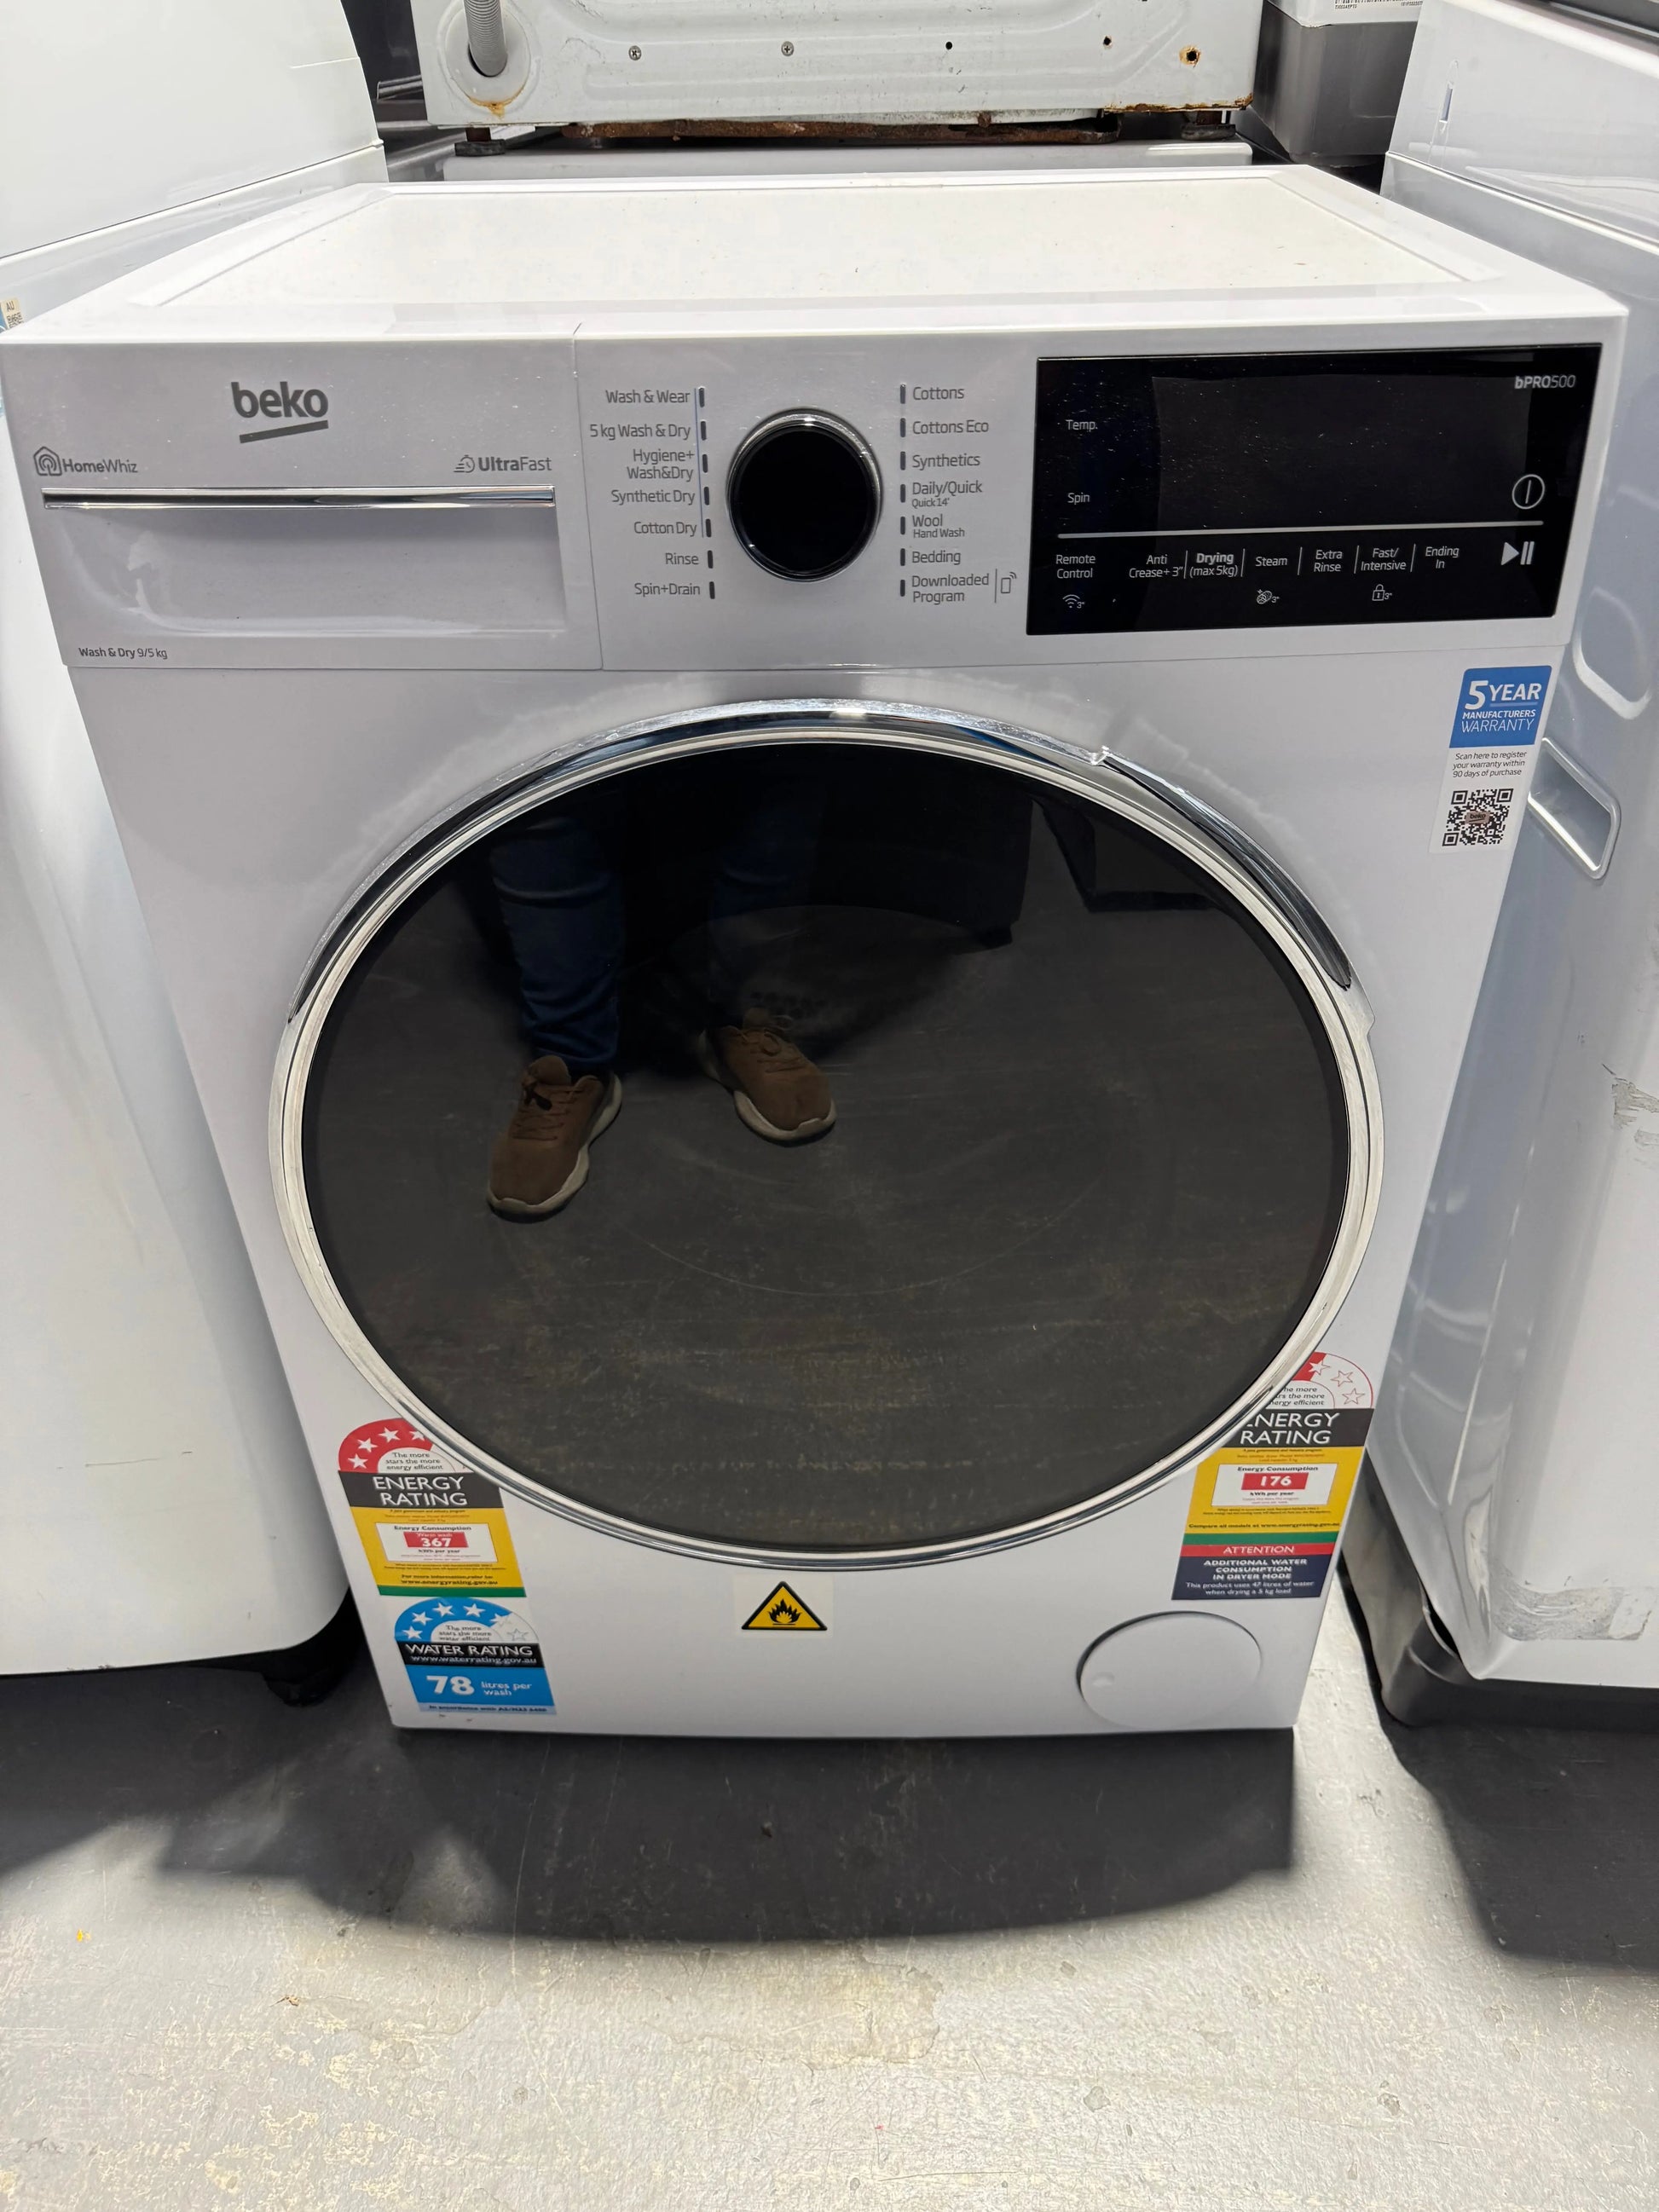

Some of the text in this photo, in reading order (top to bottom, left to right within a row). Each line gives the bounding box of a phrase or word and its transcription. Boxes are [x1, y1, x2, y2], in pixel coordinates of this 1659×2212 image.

[1515, 375, 1576, 389] bPRO500
[231, 381, 329, 419] beko
[605, 390, 691, 404] Wash & Wear
[911, 387, 965, 400] Cottons
[590, 424, 691, 440] 5 kg Wash & Dry
[911, 420, 990, 434] Cottons Eco
[1066, 419, 1098, 432] Temp.
[477, 455, 552, 472] UltraFast
[633, 448, 695, 465] Hygiene+
[911, 453, 980, 470] Synthetics
[63, 459, 138, 474] HomeWhiz
[627, 465, 694, 482] Wash&Dry
[911, 480, 983, 497] Daily/Quick
[610, 488, 696, 505] Synthetic Dry
[911, 498, 935, 509] Quick
[1067, 492, 1090, 505] Spin
[911, 514, 944, 528] Wool
[633, 521, 697, 537] Cotton Dry
[913, 528, 965, 539] Hand Wash
[664, 552, 699, 565] Rinse
[911, 551, 962, 565] Bedding
[1055, 554, 1096, 564] Remote
[1195, 552, 1234, 566] Drying
[1315, 549, 1343, 560] Extra
[1372, 547, 1400, 558] Fast/
[1425, 546, 1460, 558] Ending
[1146, 554, 1168, 565] Anti
[1255, 556, 1288, 567] Steam
[1361, 561, 1407, 571] Intensive
[1435, 559, 1445, 569] In
[1056, 568, 1093, 579] Control
[1129, 567, 1171, 578] Crease+
[1189, 564, 1239, 579] (max 5kg)
[1313, 562, 1342, 573] Rinse
[911, 573, 990, 588] Downloaded
[634, 583, 701, 598] Spin+Drain
[912, 590, 965, 606] Program
[78, 647, 168, 661] Wash & Dry 9/5 kg
[1465, 679, 1542, 710] 5 YEAR
[1462, 709, 1536, 719] MANUFACTURERS
[1461, 719, 1535, 733] WARRANTY
[1500, 751, 1527, 759] register
[1470, 761, 1502, 770] warranty
[1464, 770, 1481, 778] days
[1489, 768, 1522, 777] purchase
[1246, 1412, 1340, 1428] NERGY
[1240, 1430, 1332, 1445] RATING
[373, 1476, 464, 1490] ENERGY
[1260, 1476, 1292, 1487] 176
[380, 1492, 467, 1506] RATING
[420, 1538, 452, 1547] 367
[1223, 1545, 1295, 1554] ATTENTION
[406, 1643, 533, 1655] WATER RATING
[411, 1655, 537, 1665] www.waterrating.gov.au
[426, 1675, 474, 1695] 78
